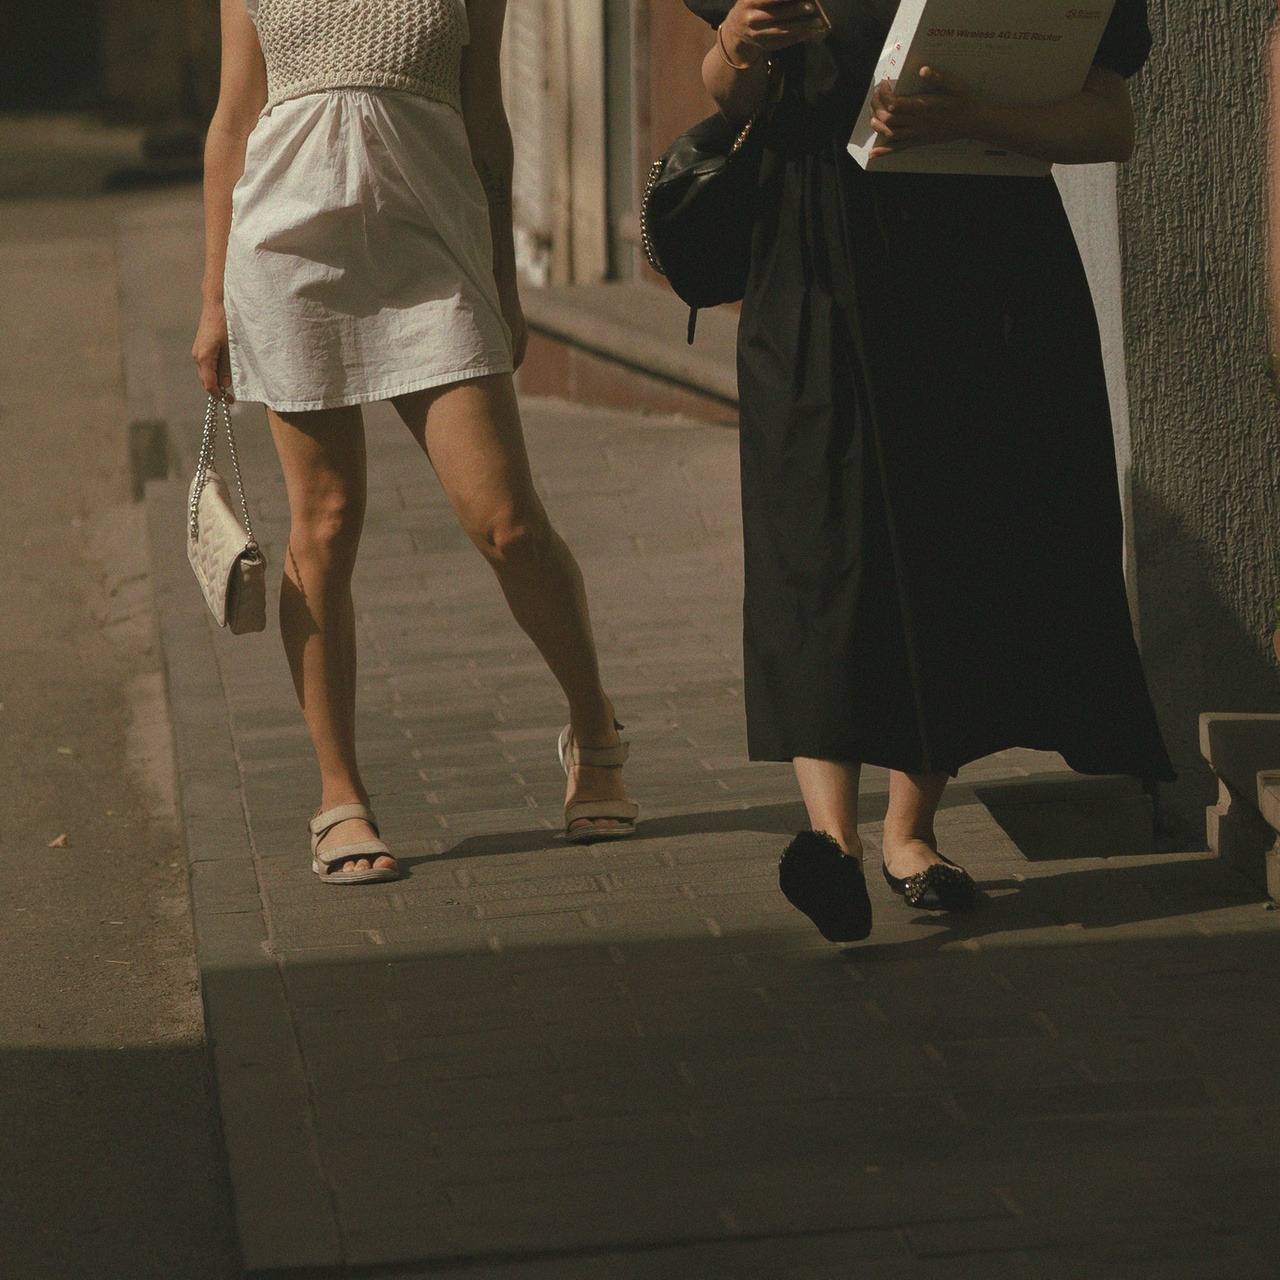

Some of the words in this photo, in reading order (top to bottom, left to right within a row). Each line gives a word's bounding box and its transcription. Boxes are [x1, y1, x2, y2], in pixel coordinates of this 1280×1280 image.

[926, 28, 956, 38] 300M
[957, 29, 996, 39] Wireless
[997, 31, 1012, 40] 4G
[1013, 32, 1031, 41] LTE
[1031, 32, 1064, 43] Router
